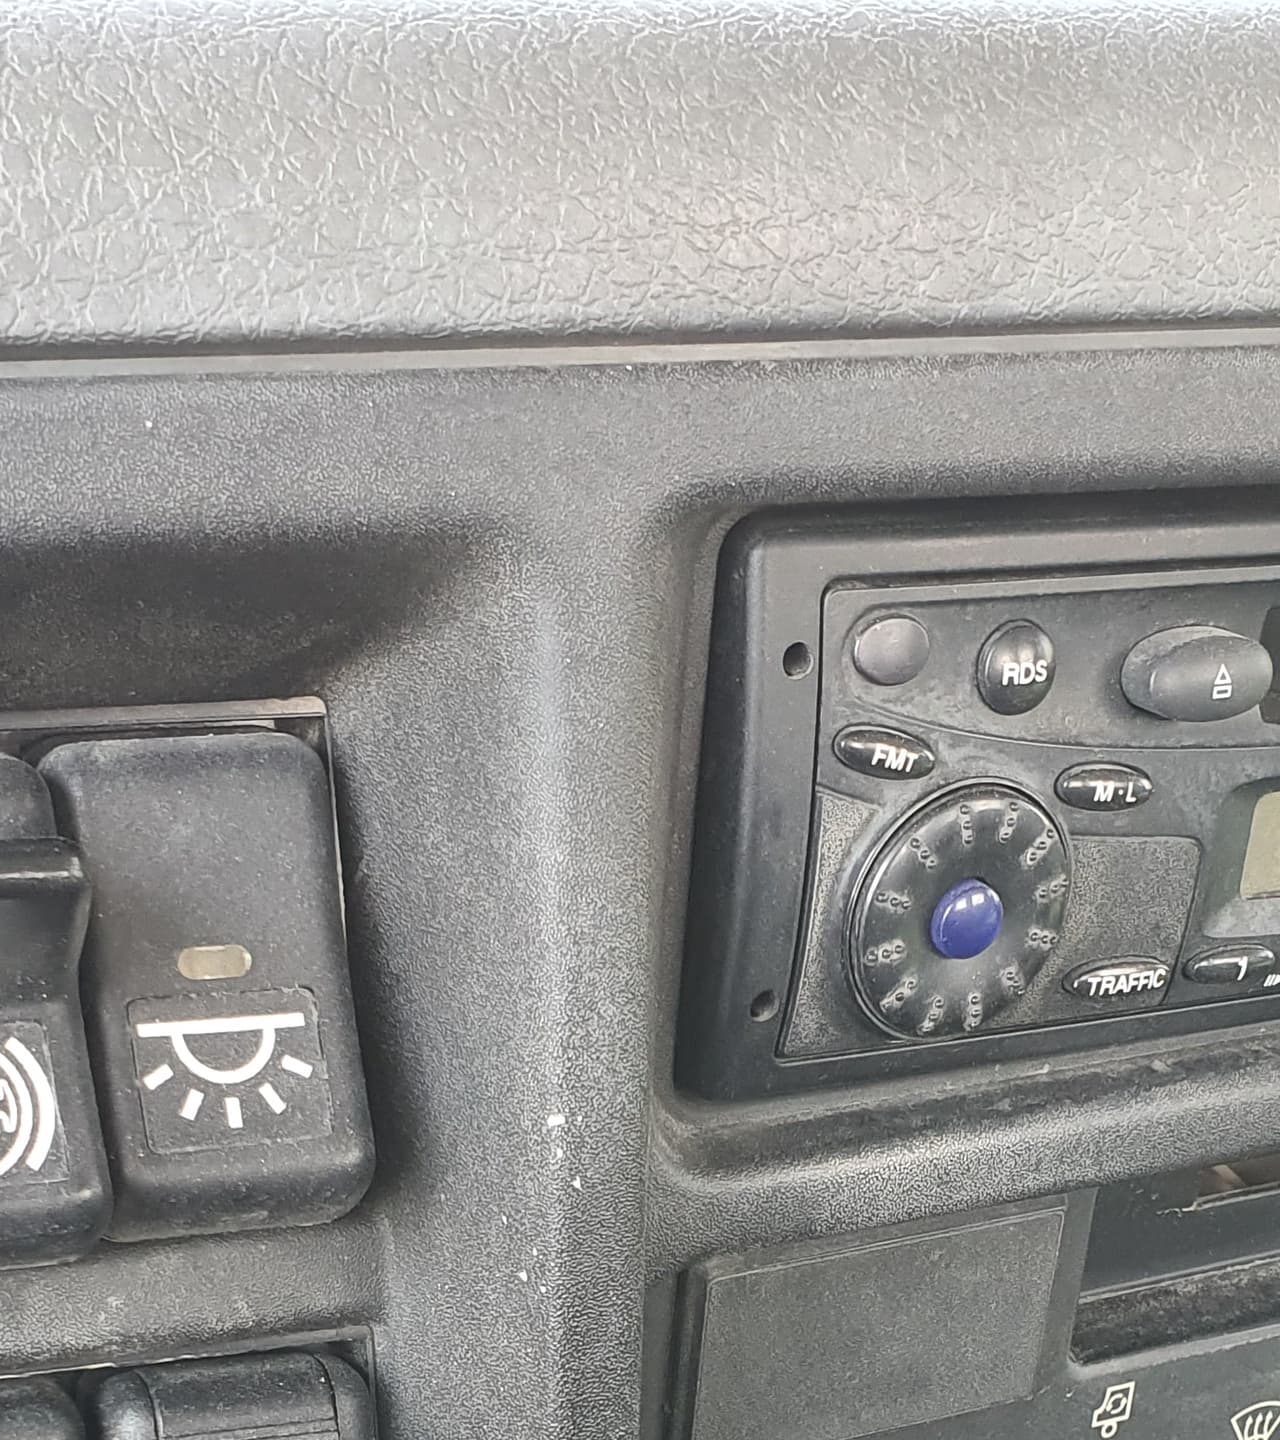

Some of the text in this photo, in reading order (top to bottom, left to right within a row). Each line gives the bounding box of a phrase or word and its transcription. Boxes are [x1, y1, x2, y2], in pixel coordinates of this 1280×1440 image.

[1002, 660, 1048, 686] RDS
[871, 744, 919, 772] FMT
[1236, 956, 1248, 981] 1
[1087, 971, 1167, 996] TRAFFIC
